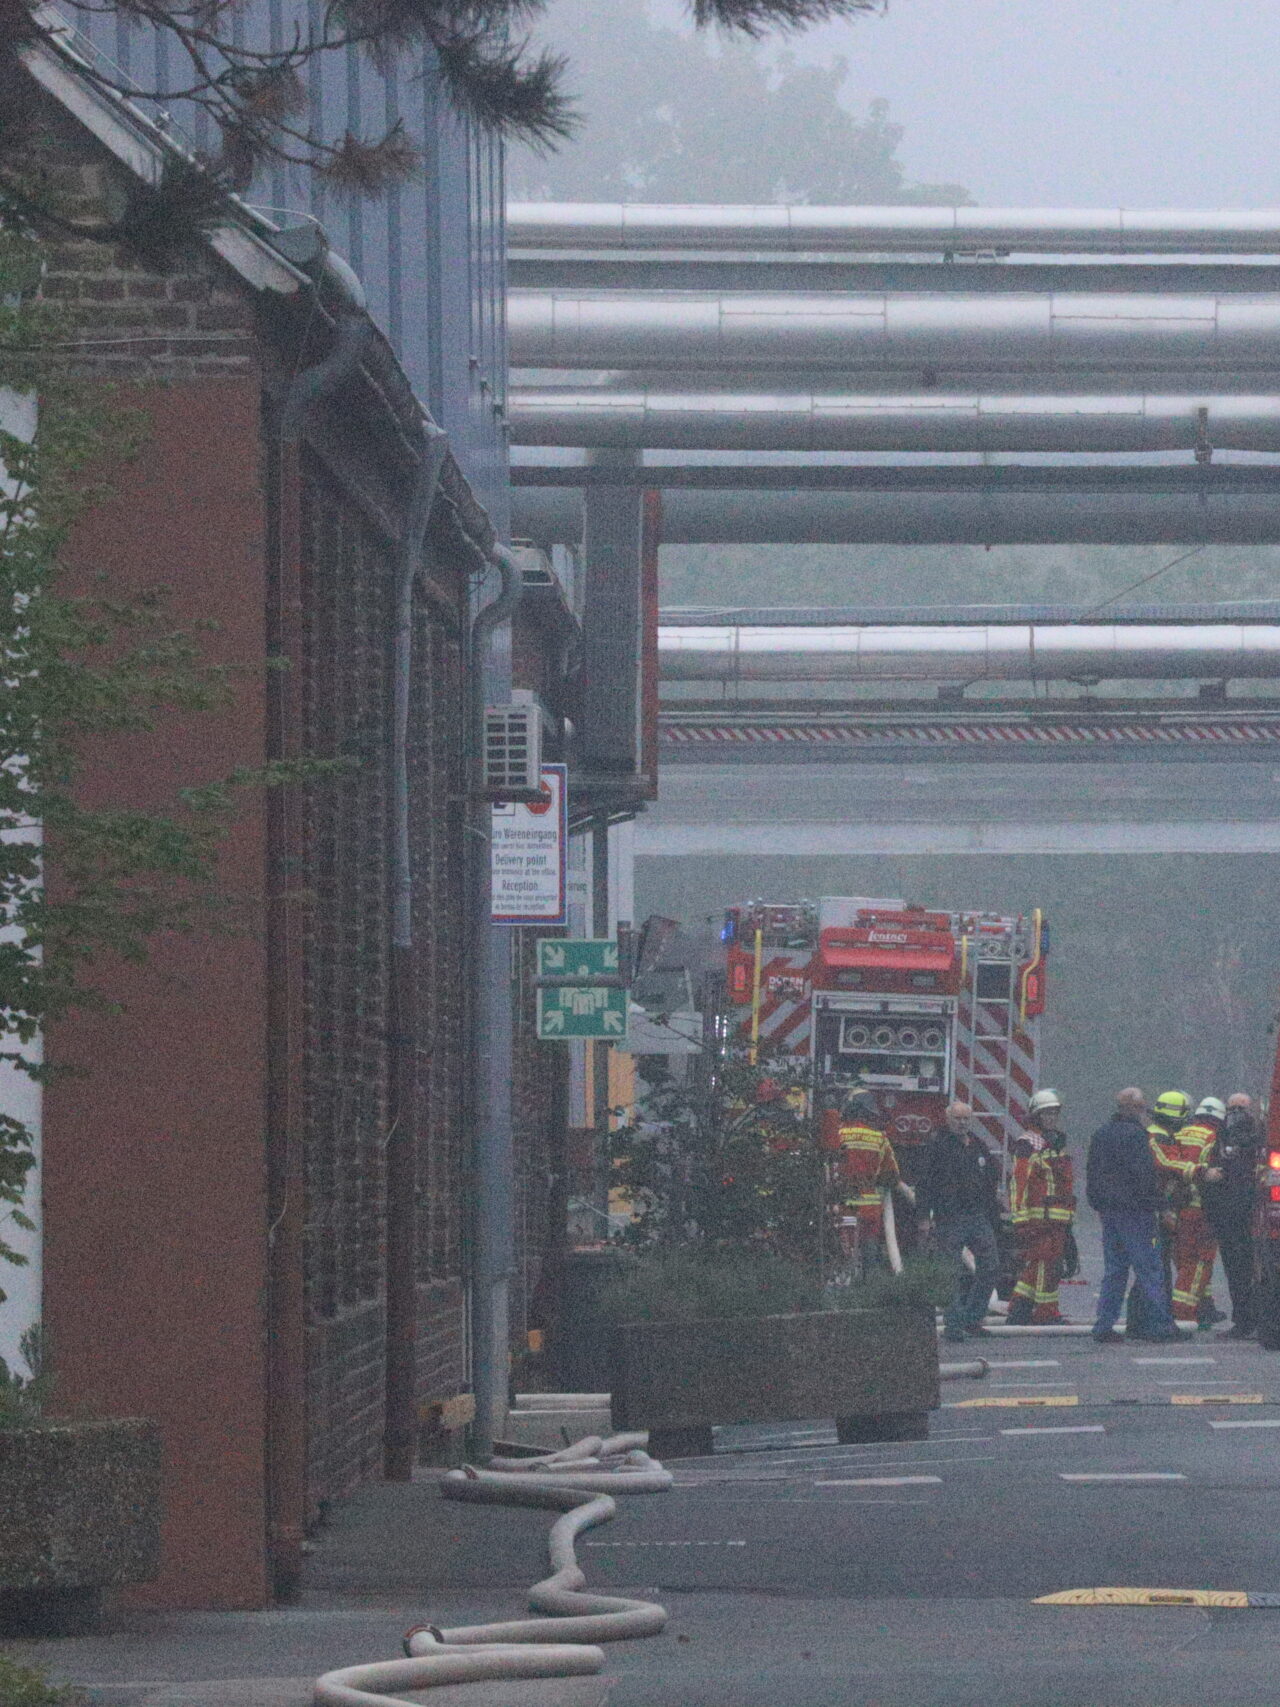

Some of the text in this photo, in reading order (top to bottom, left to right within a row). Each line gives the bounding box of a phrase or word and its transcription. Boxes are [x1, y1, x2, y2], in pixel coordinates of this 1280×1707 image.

[503, 828, 557, 843] Wareneingang
[495, 853, 547, 868] Delivery point
